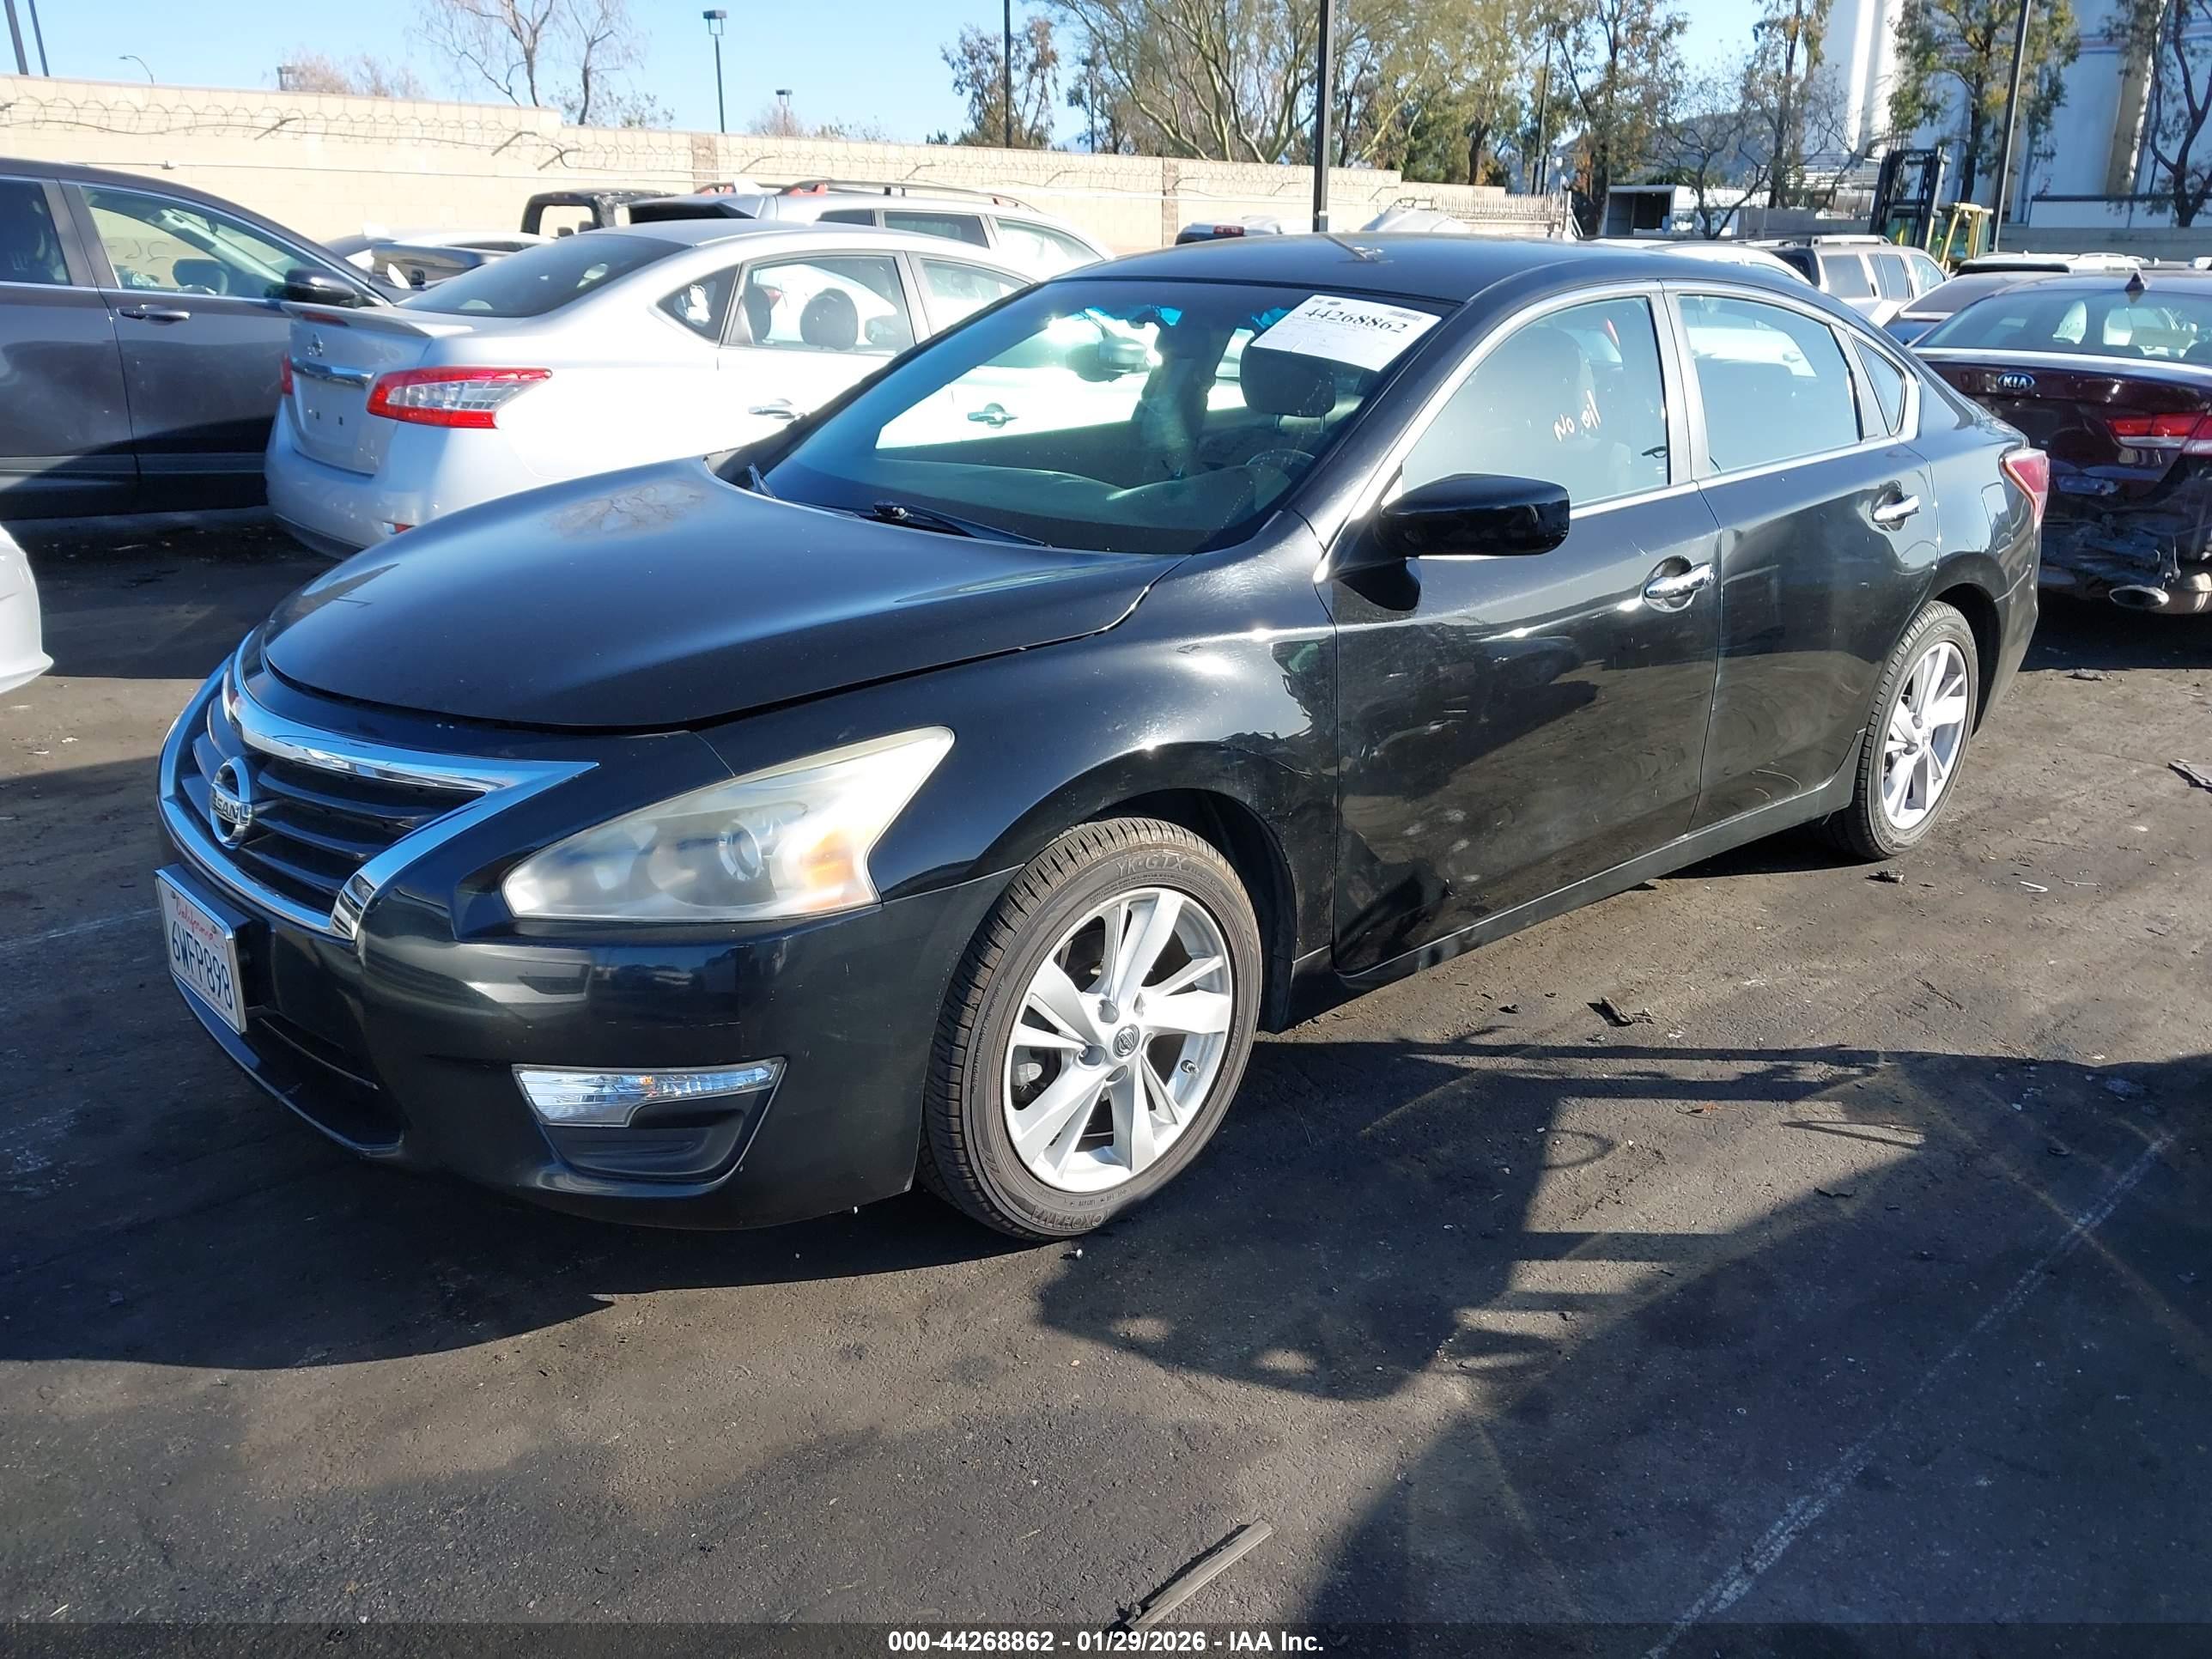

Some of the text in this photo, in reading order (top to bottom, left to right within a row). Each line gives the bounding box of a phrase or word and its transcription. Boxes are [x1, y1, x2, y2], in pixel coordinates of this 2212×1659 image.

[1304, 307, 1408, 333] 44268862
[2003, 374, 2028, 389] KIA
[172, 920, 234, 1011] 6WFP898
